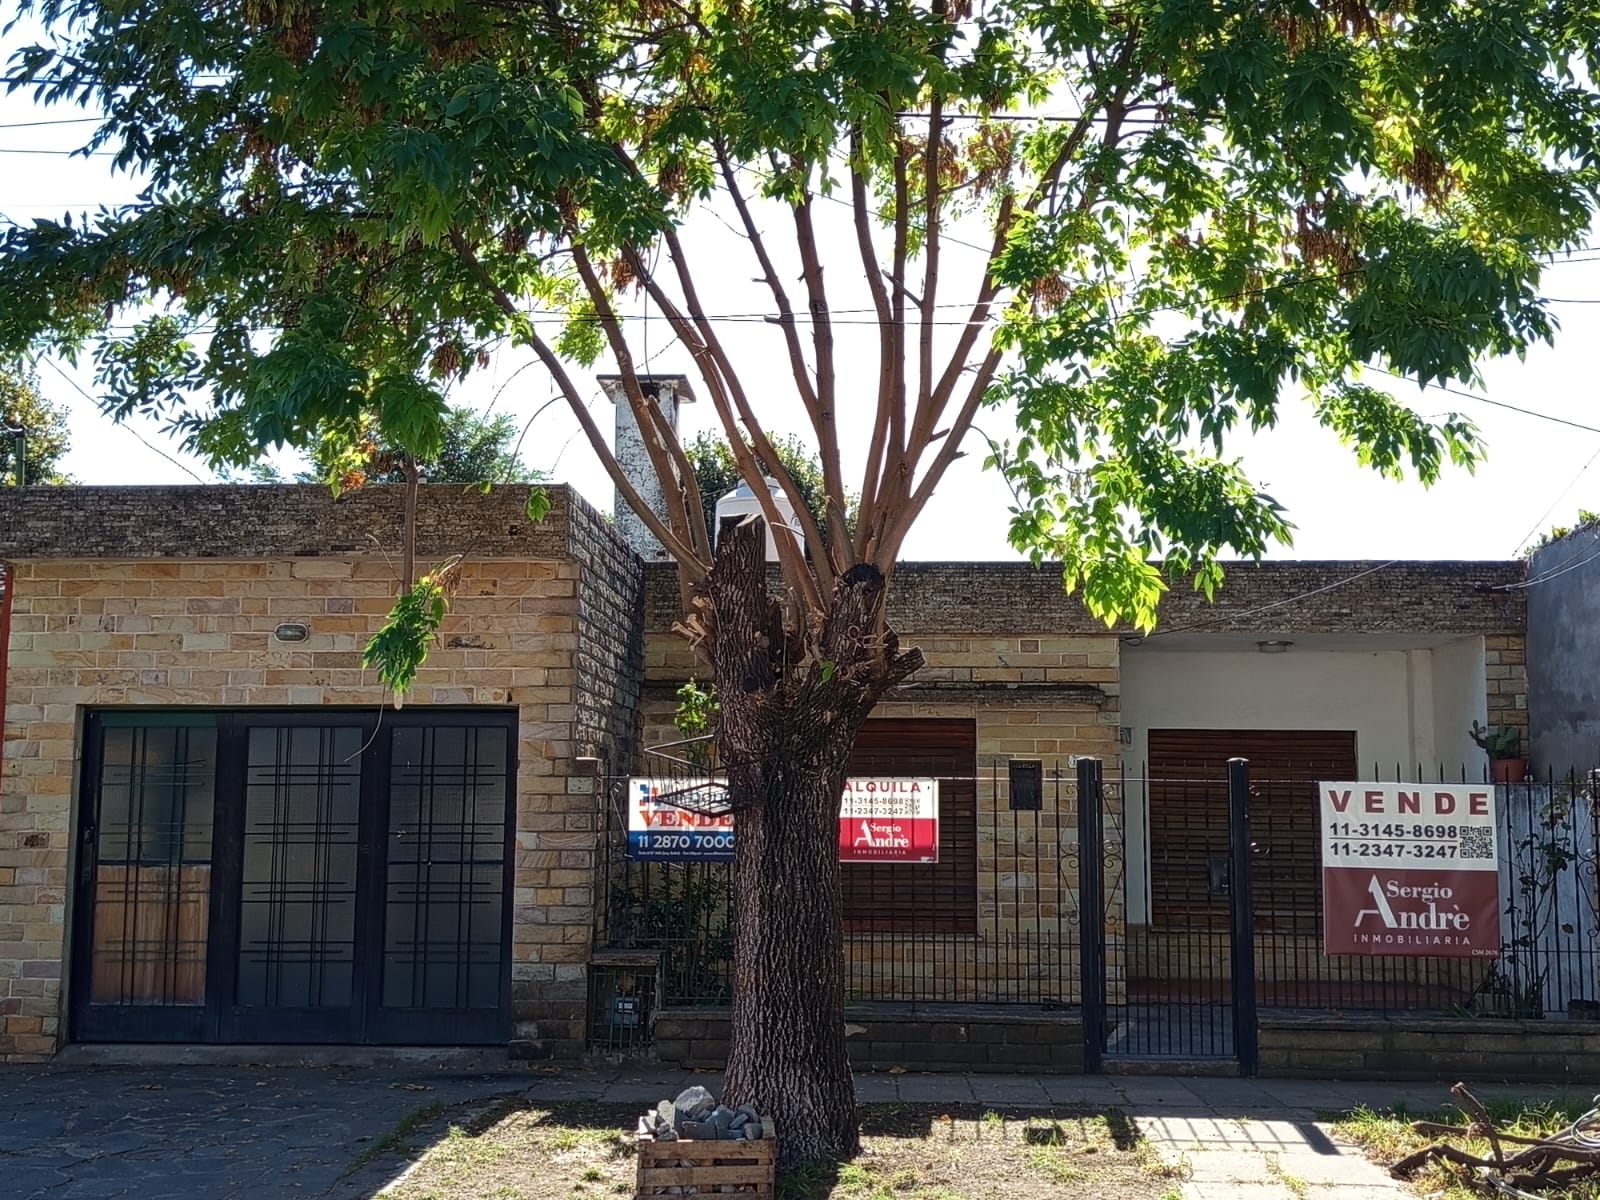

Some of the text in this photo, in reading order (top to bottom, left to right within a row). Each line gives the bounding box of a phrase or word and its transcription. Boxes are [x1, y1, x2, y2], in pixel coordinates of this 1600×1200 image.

[842, 781, 921, 793] ALQUILA
[1328, 790, 1489, 816] VENDE
[639, 810, 733, 827] VENDE
[870, 822, 902, 834] Sergio
[1329, 823, 1458, 838] 11-3145-8698
[638, 835, 649, 848] 11
[653, 835, 690, 848] 2870
[1330, 842, 1458, 859] 11-2347-3247
[1386, 880, 1453, 903] Sergio
[1353, 934, 1471, 946] INMOBILIARIA
